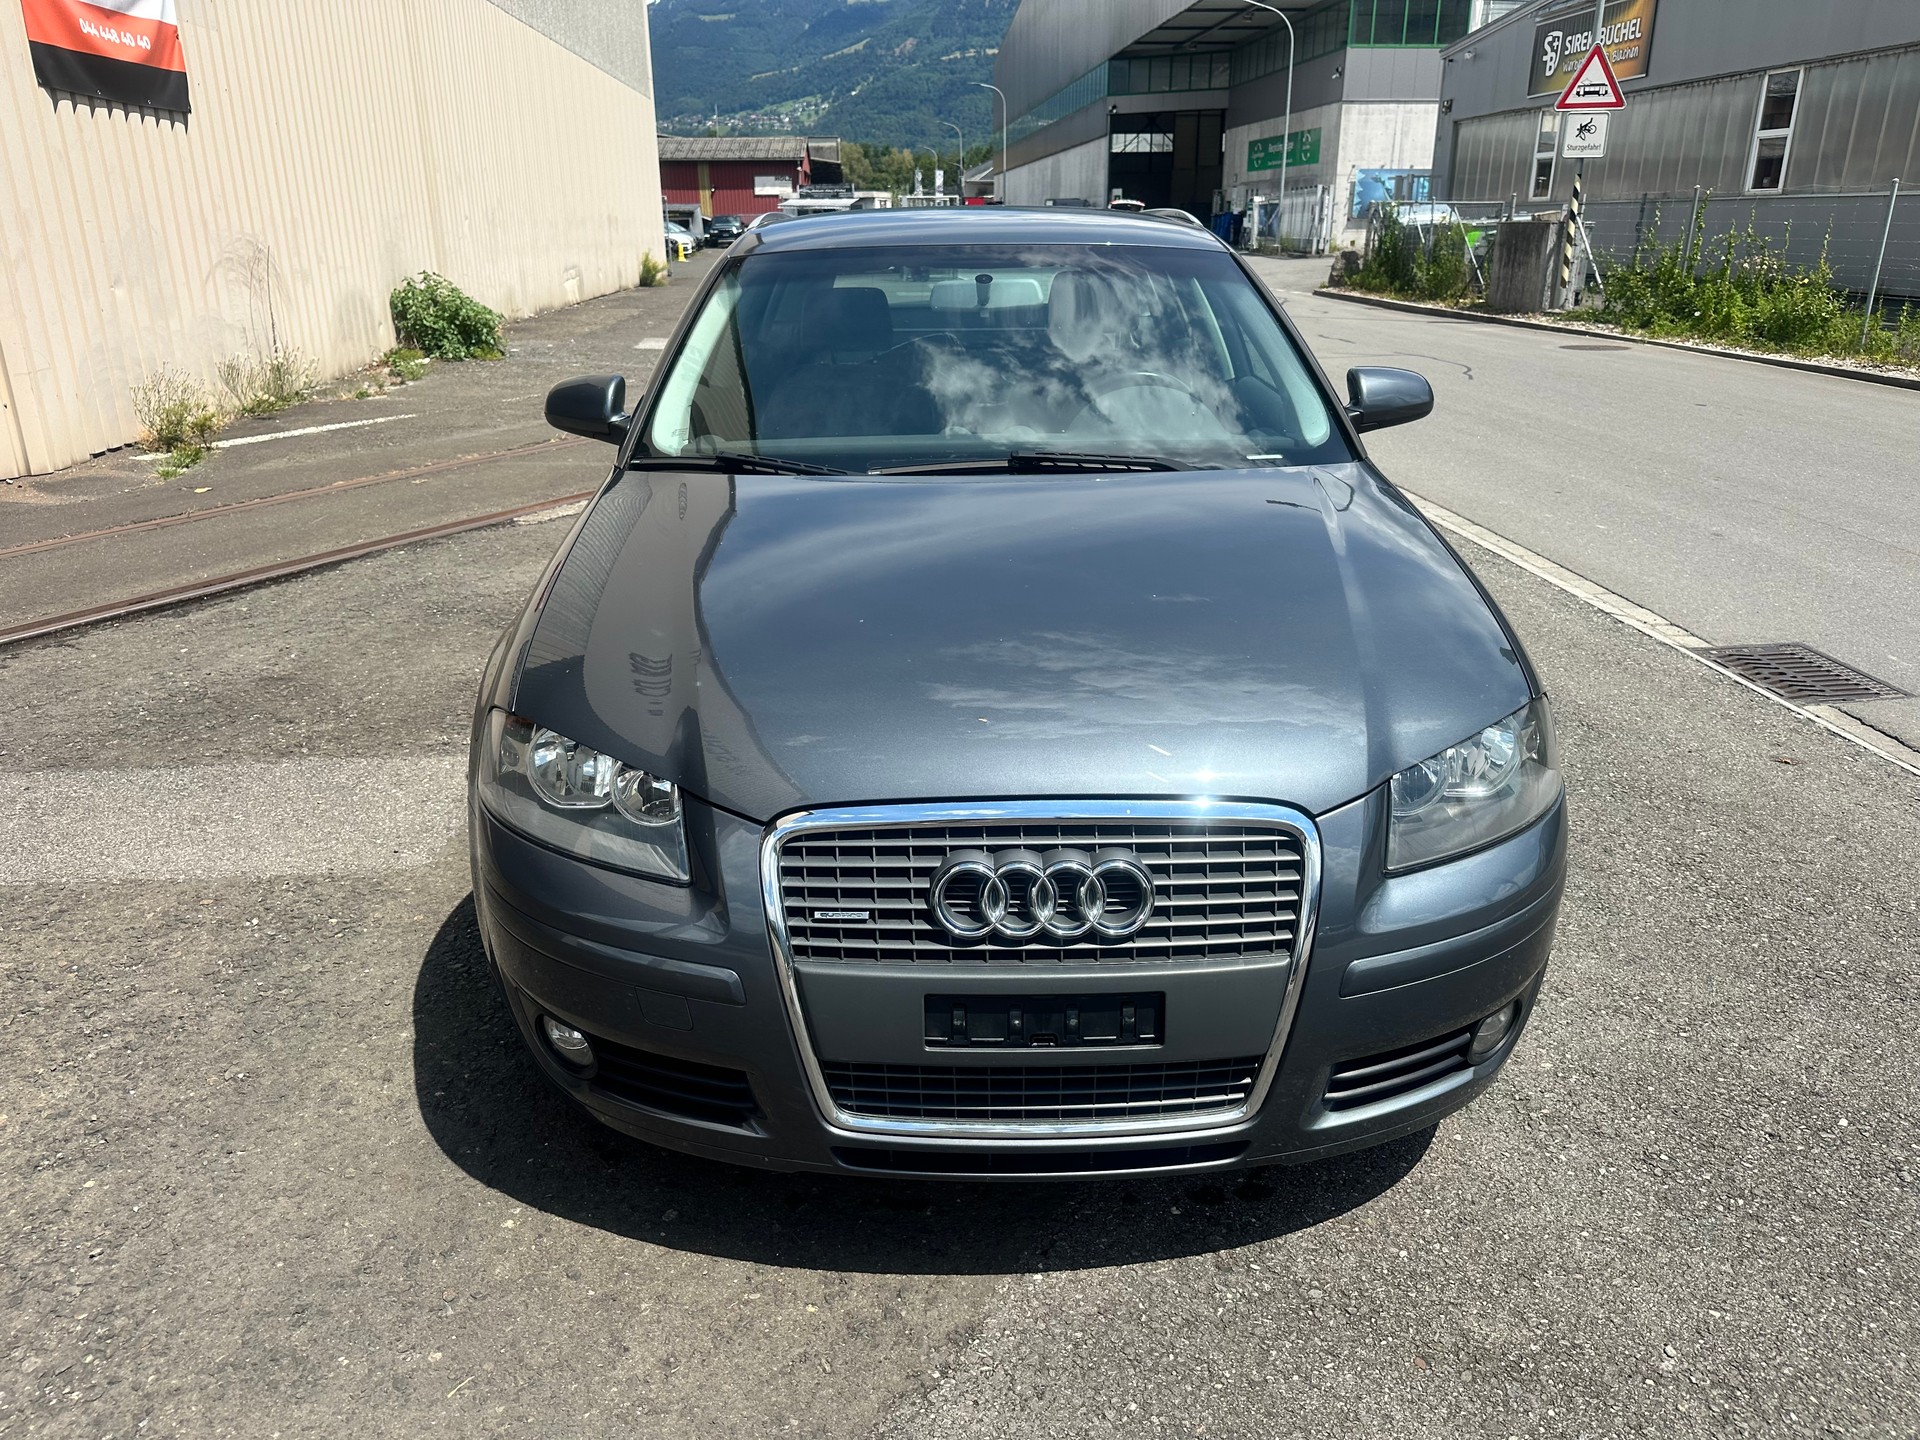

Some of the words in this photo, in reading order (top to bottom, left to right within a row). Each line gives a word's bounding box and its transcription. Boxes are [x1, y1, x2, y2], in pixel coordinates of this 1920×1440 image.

[79, 17, 99, 38] 044
[99, 25, 120, 44] 448
[121, 31, 136, 47] 40
[137, 34, 151, 50] 40
[1566, 143, 1602, 152] Sturzgefahr!
